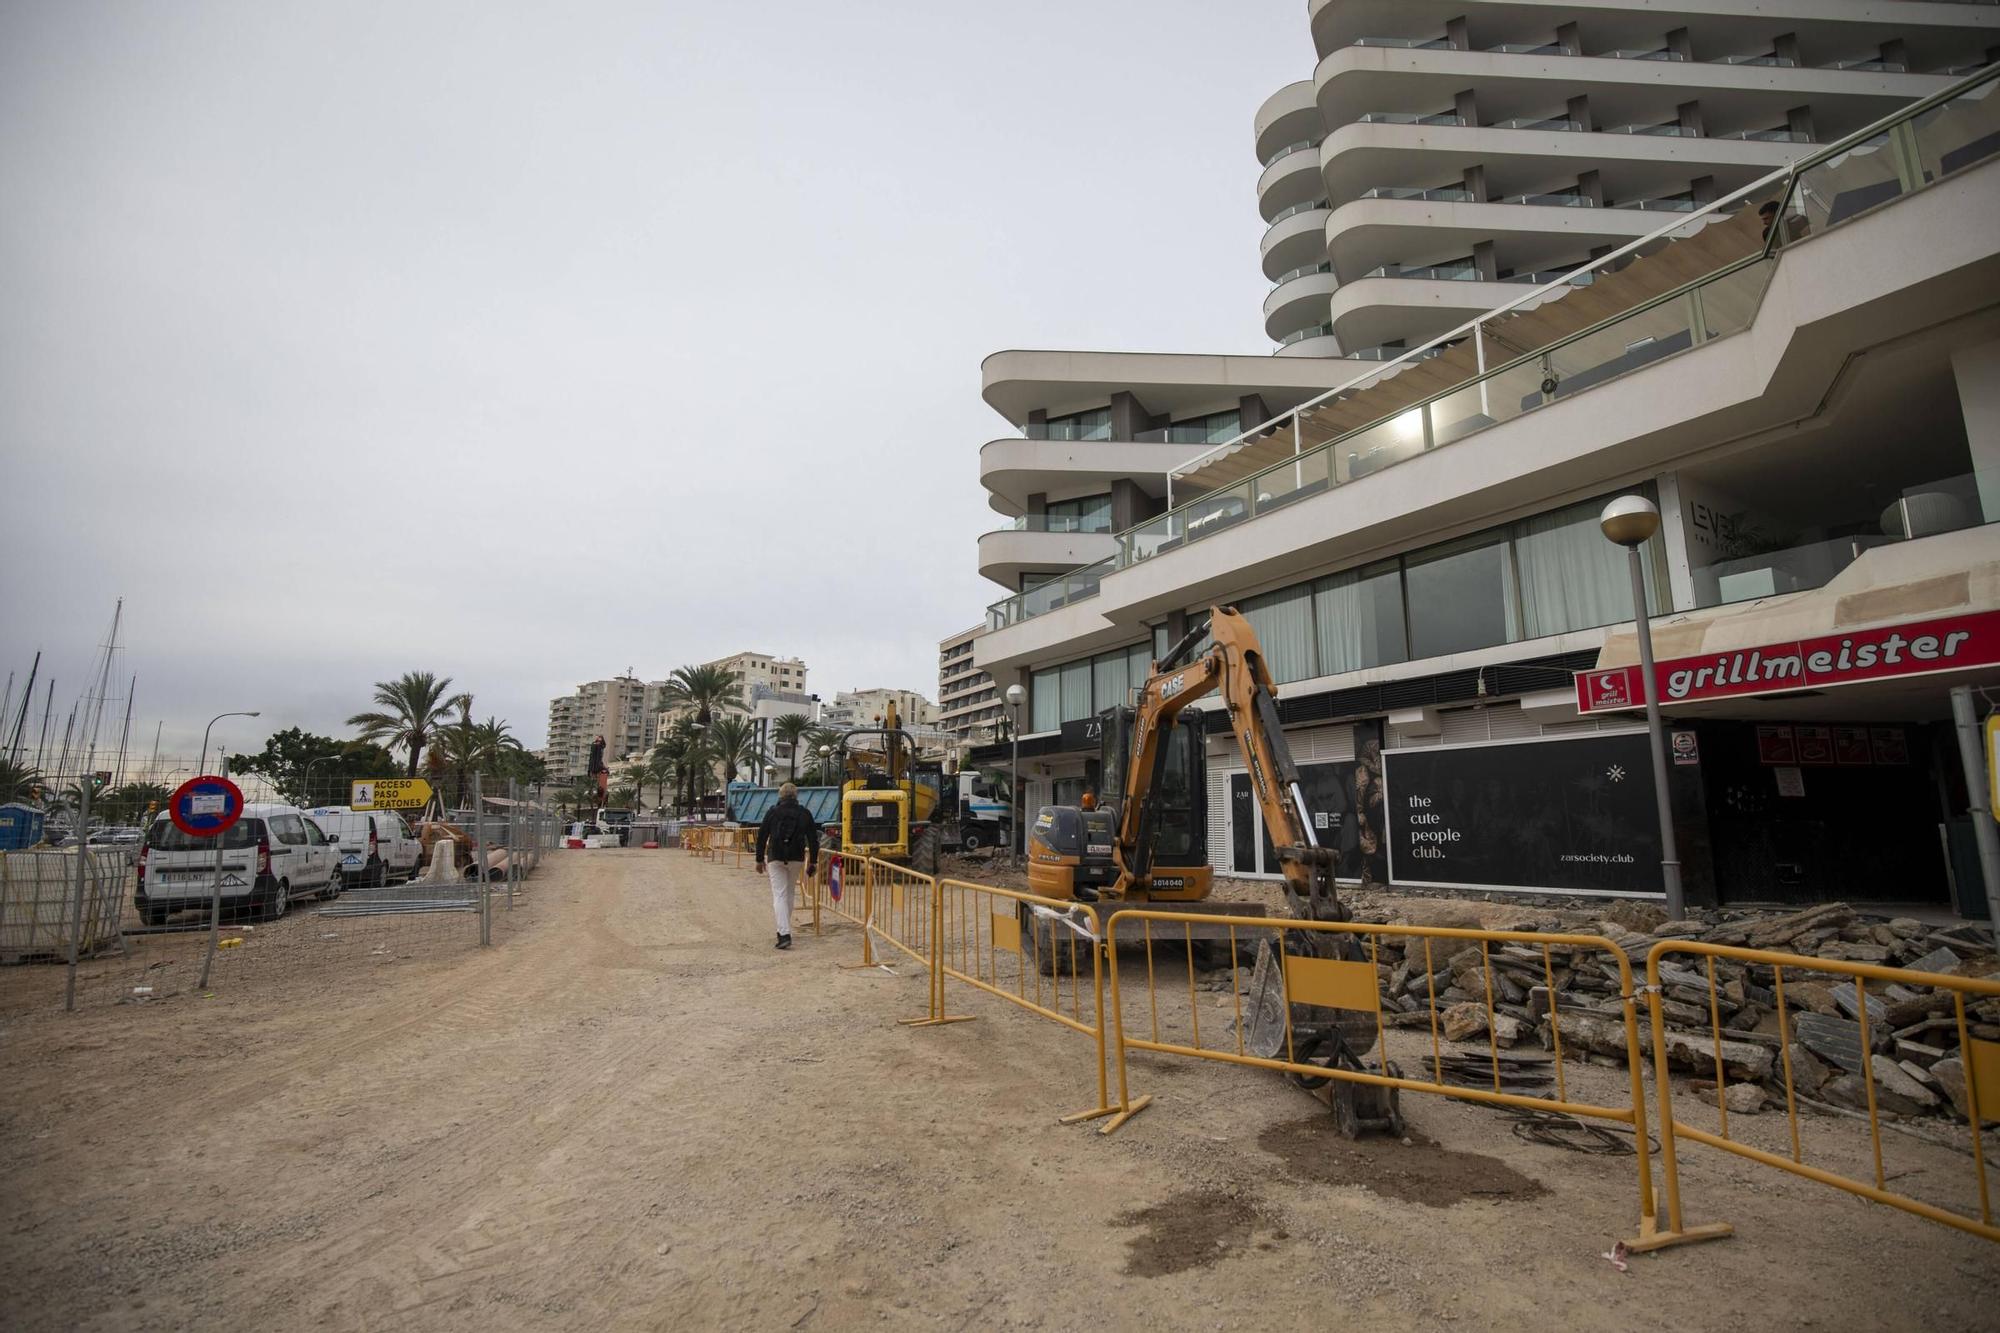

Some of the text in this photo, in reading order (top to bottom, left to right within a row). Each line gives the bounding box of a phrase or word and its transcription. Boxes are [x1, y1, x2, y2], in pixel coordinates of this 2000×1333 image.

[1666, 630, 1970, 698] grillmeister
[1161, 673, 1184, 699] CASE
[1595, 697, 1626, 705] meister
[1601, 690, 1618, 700] grill
[374, 781, 412, 789] ACCESO
[374, 790, 399, 799] PASO
[374, 799, 421, 808] PEATONES
[1409, 795, 1432, 808] the
[1410, 811, 1440, 825] cute
[1411, 828, 1461, 844] people
[1412, 846, 1446, 859] club.
[1560, 853, 1635, 864] zarsociety.club
